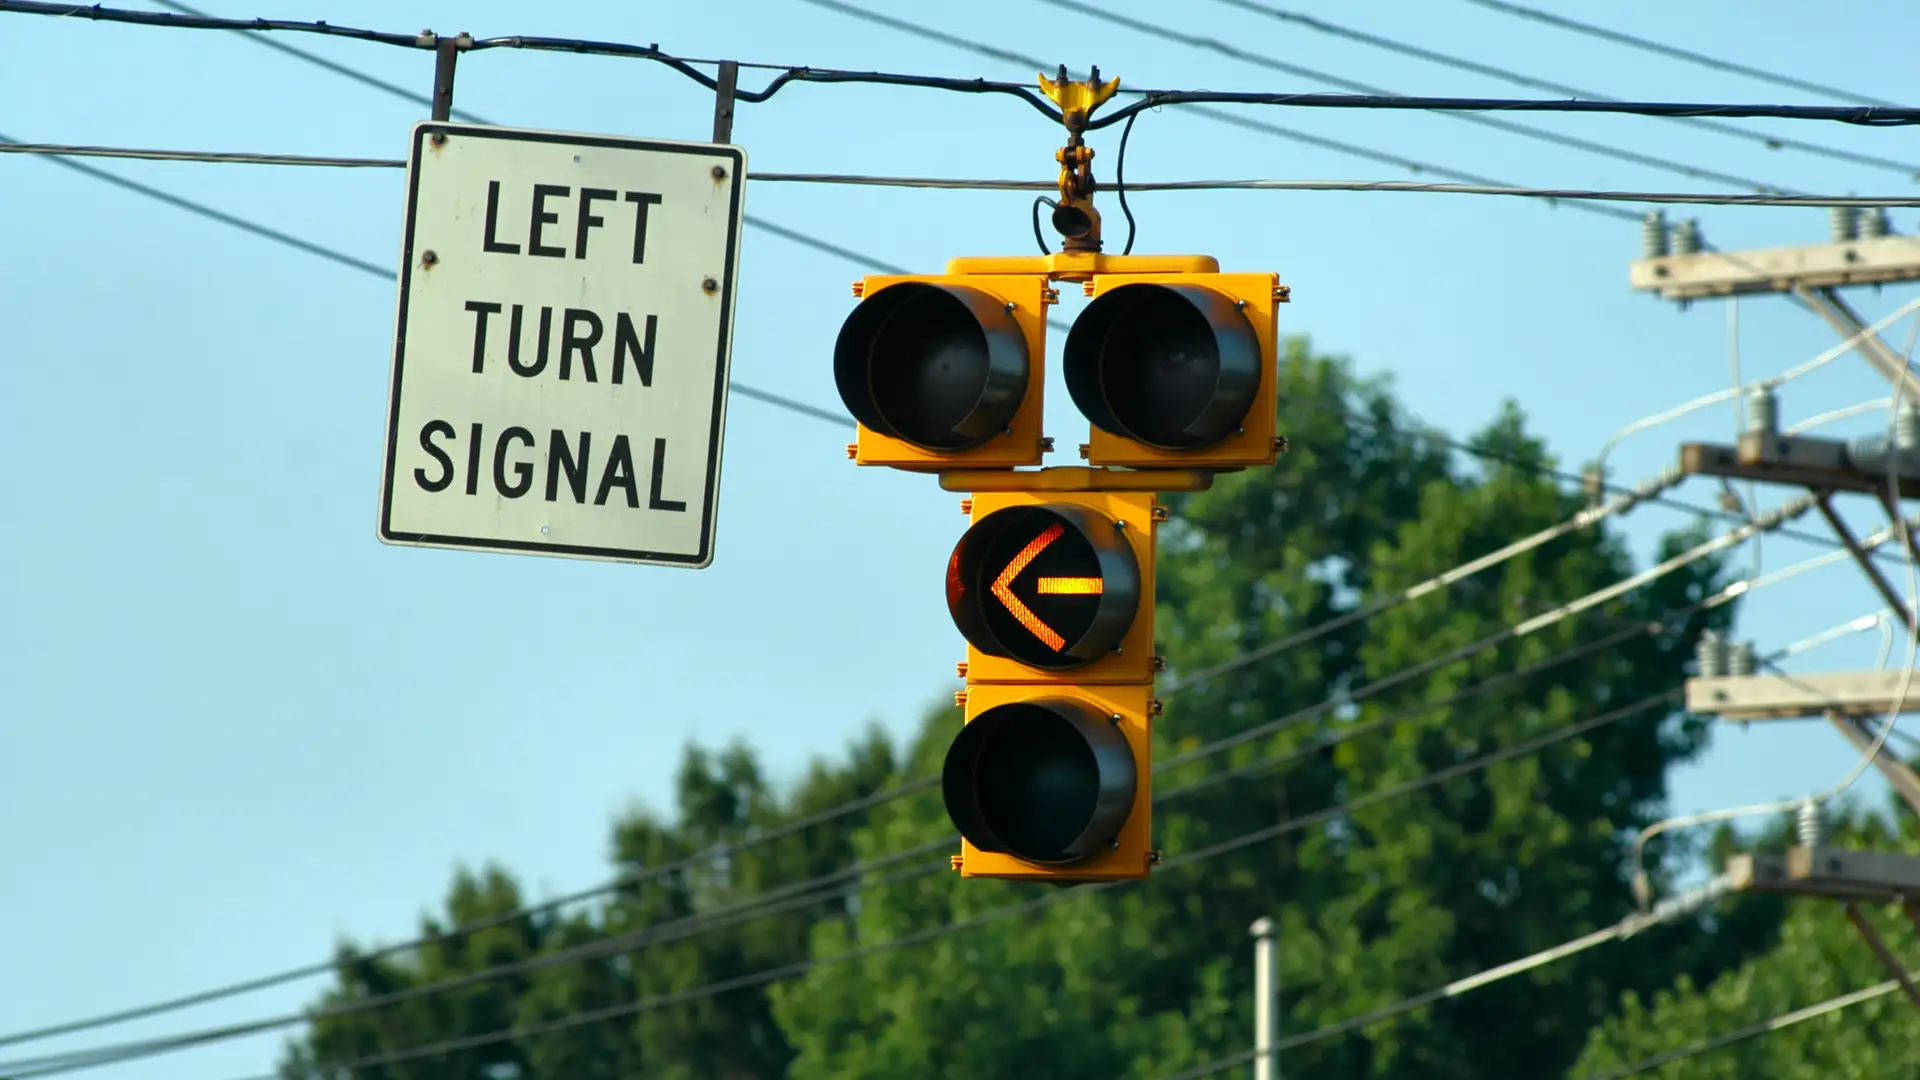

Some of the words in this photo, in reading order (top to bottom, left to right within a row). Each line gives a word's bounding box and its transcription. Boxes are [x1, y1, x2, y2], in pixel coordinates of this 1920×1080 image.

[483, 180, 663, 265] LEFT
[464, 300, 658, 388] TURN
[413, 418, 687, 513] SIGNAL
